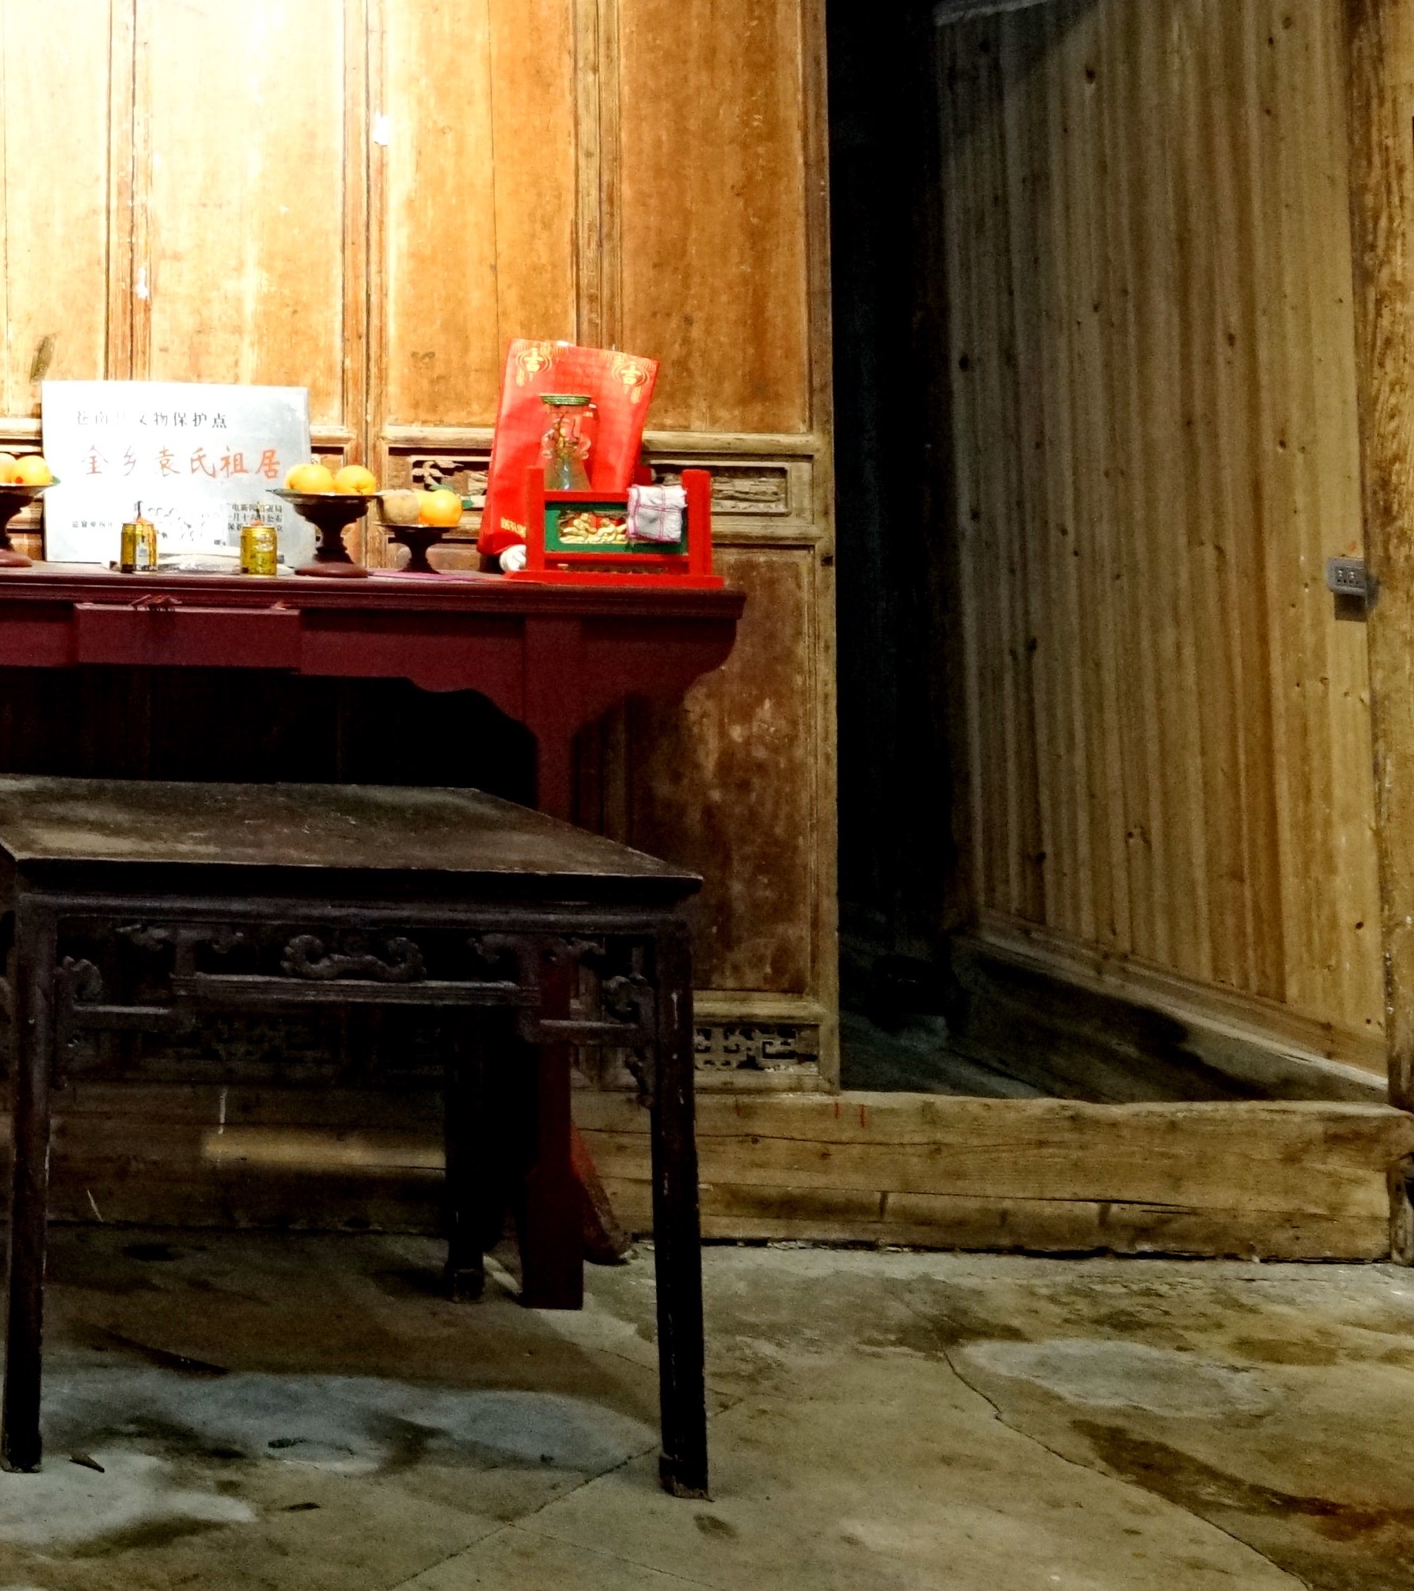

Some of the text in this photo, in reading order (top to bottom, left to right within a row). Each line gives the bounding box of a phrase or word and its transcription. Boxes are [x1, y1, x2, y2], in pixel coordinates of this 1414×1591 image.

[82, 444, 281, 480] 金乡袁氏祖居
